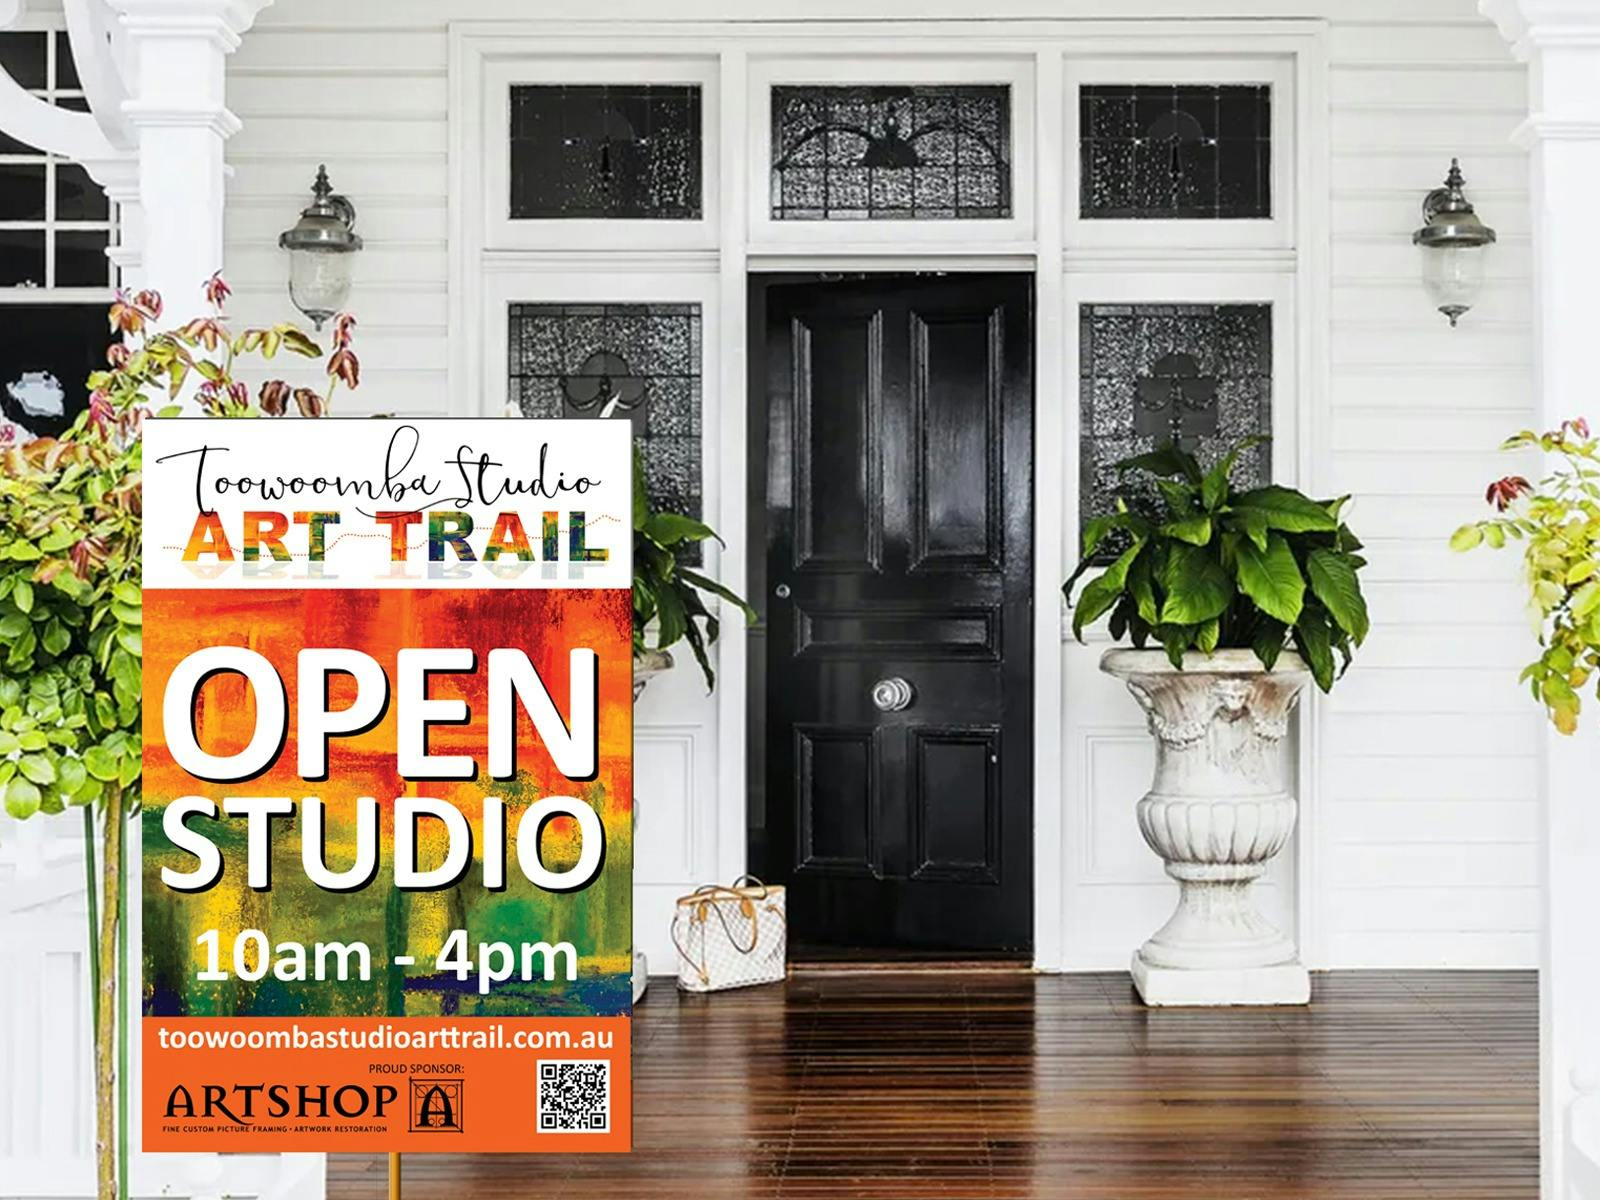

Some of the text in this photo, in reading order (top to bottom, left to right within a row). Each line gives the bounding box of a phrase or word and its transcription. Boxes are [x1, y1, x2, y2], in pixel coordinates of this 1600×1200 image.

[156, 425, 602, 517] Toowoomba Studio
[181, 511, 610, 562] ART TRAIL
[162, 646, 600, 783] OPEN
[160, 796, 607, 893] STUDIO
[195, 928, 372, 982] 10am
[435, 929, 578, 995] 4pm
[158, 1024, 615, 1050] toowoombastudioarttrail.com.au
[369, 1064, 465, 1074] PROUD SPONSOR:
[163, 1082, 398, 1126] ARTSHOP
